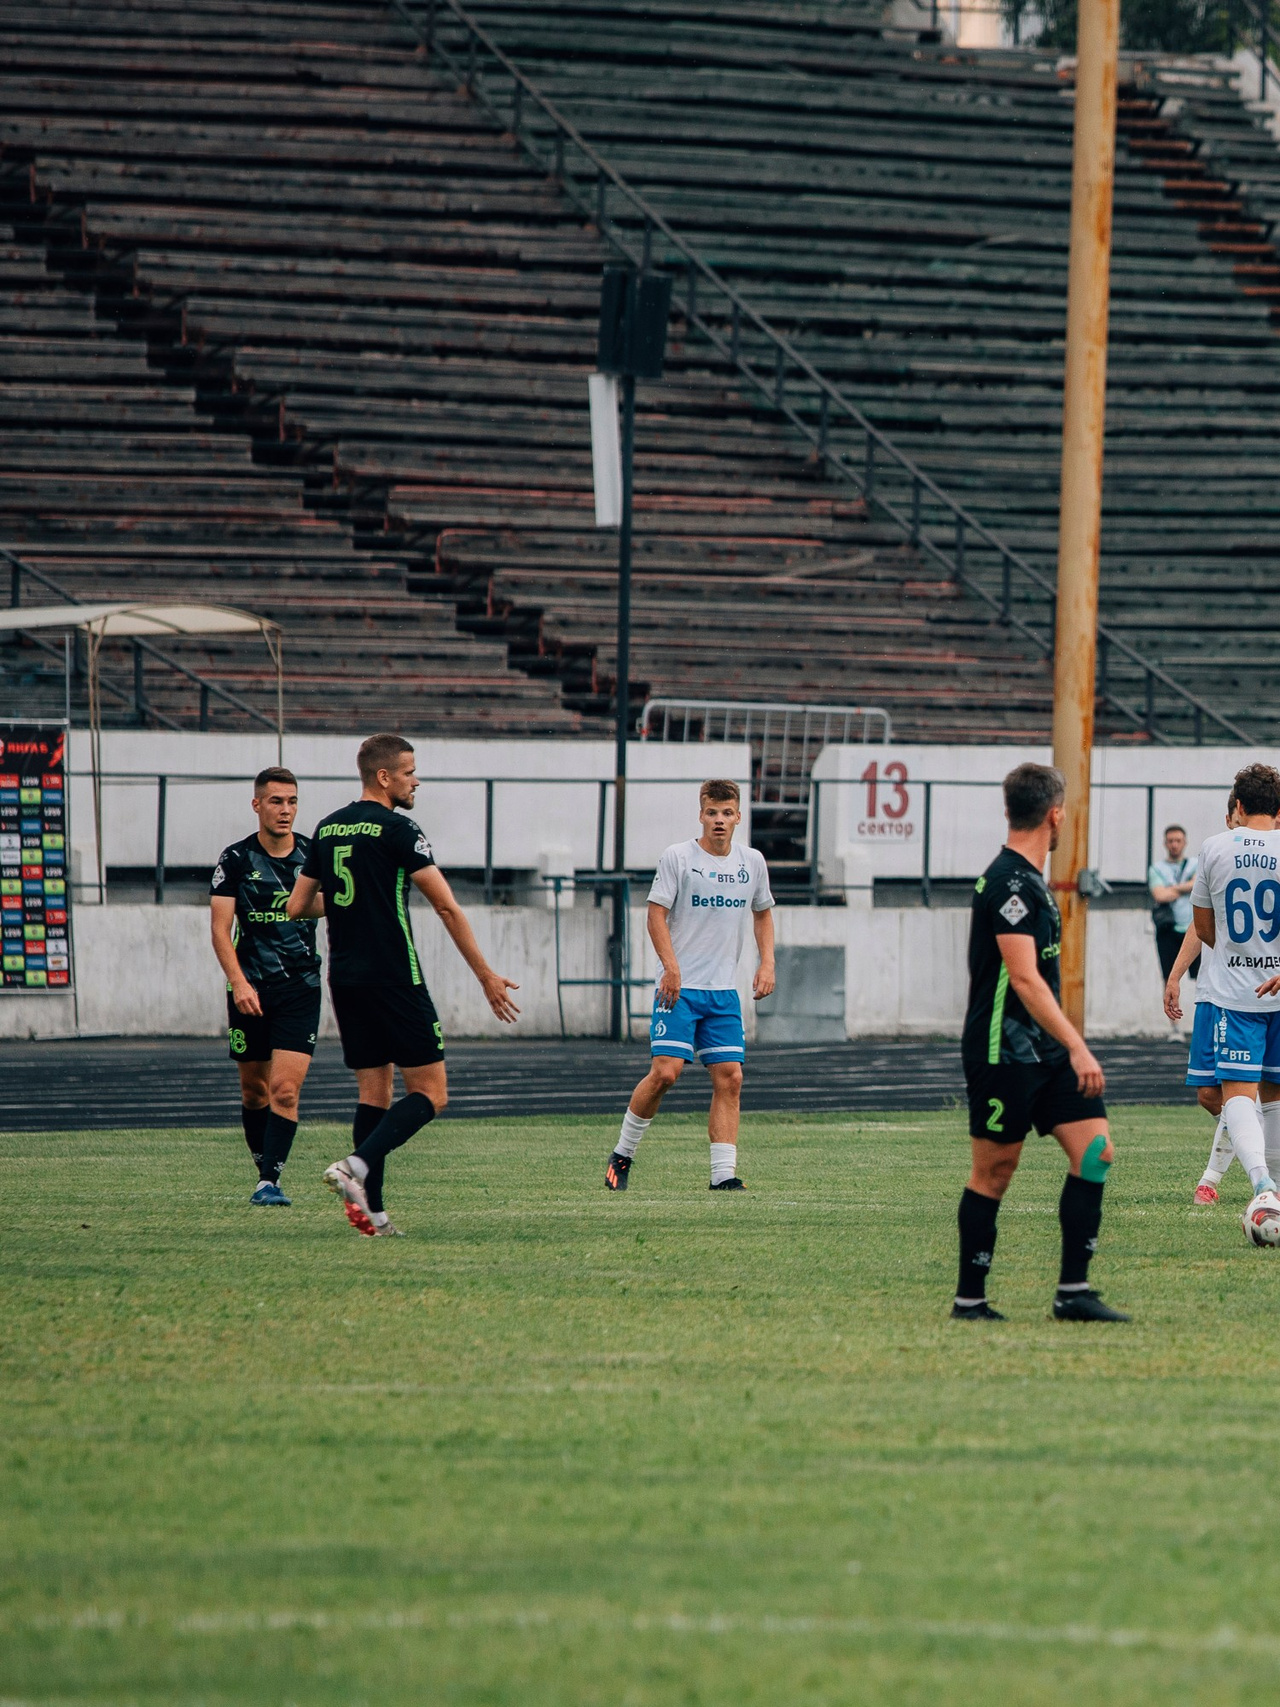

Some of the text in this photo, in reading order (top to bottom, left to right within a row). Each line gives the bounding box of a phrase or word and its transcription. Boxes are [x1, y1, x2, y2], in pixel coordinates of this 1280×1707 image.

[861, 761, 910, 819] 13
[857, 822, 914, 838] сектор
[1243, 838, 1265, 847] ВТБ
[1234, 853, 1277, 870] БОКОВ
[333, 845, 355, 907] 5
[718, 874, 735, 883] ВТБ
[1229, 1050, 1250, 1061] ВТБ
[986, 1098, 1004, 1132] 2
